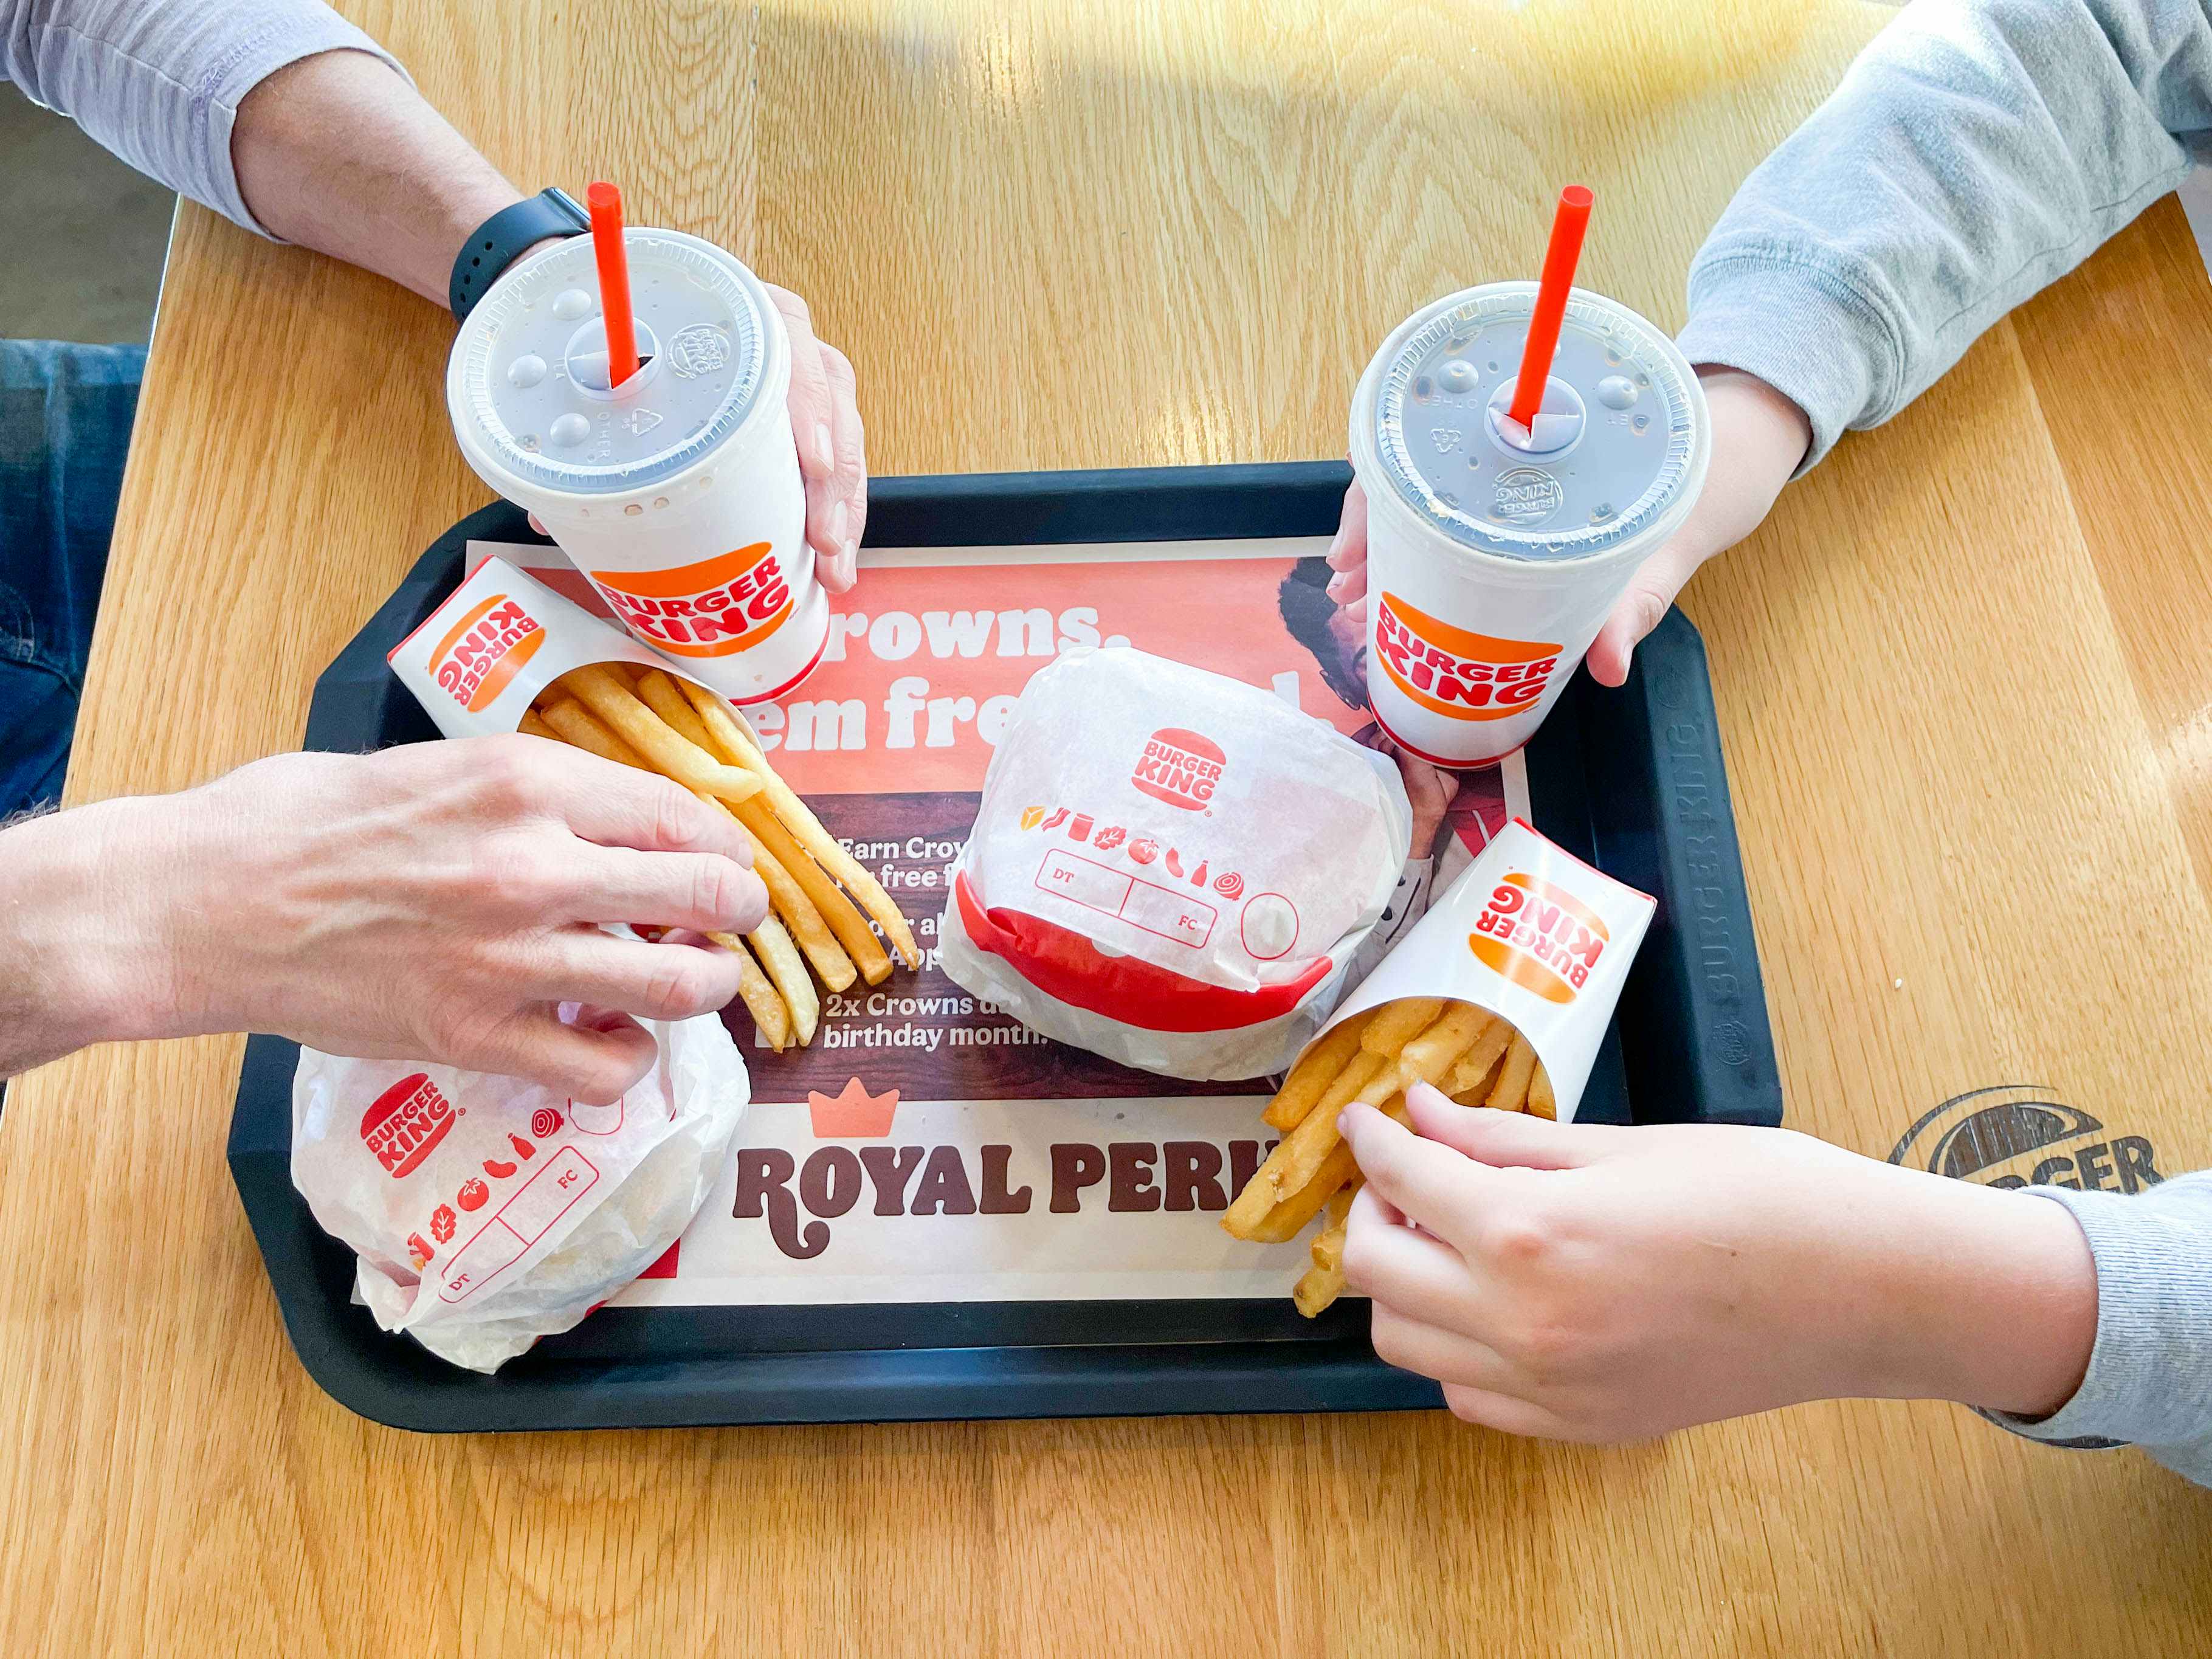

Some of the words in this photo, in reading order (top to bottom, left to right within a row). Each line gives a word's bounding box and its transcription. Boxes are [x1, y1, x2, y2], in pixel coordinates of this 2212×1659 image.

[597, 556, 781, 617] BURGER
[610, 576, 789, 643] KING
[438, 601, 526, 694] KING
[453, 616, 540, 706] BURGER
[1376, 619, 1549, 706] KING
[1379, 601, 1557, 683] BURGER
[1134, 756, 1216, 801] KING
[1143, 740, 1223, 782] BURGER
[837, 838, 900, 860] Earn
[881, 863, 938, 888] free
[1052, 867, 1075, 884] DT
[1177, 914, 1198, 931] FC
[1475, 911, 1589, 989] BURGER
[1487, 885, 1604, 968] KING
[825, 994, 860, 1017] 2x
[866, 993, 973, 1017] Crowns
[823, 1022, 944, 1052] birthday
[948, 1022, 1049, 1046] month.
[366, 1080, 439, 1154] BURGER
[376, 1093, 450, 1172] KING
[556, 1168, 579, 1190] FC
[732, 1144, 1033, 1260] ROYAL
[448, 1272, 472, 1292] DT
